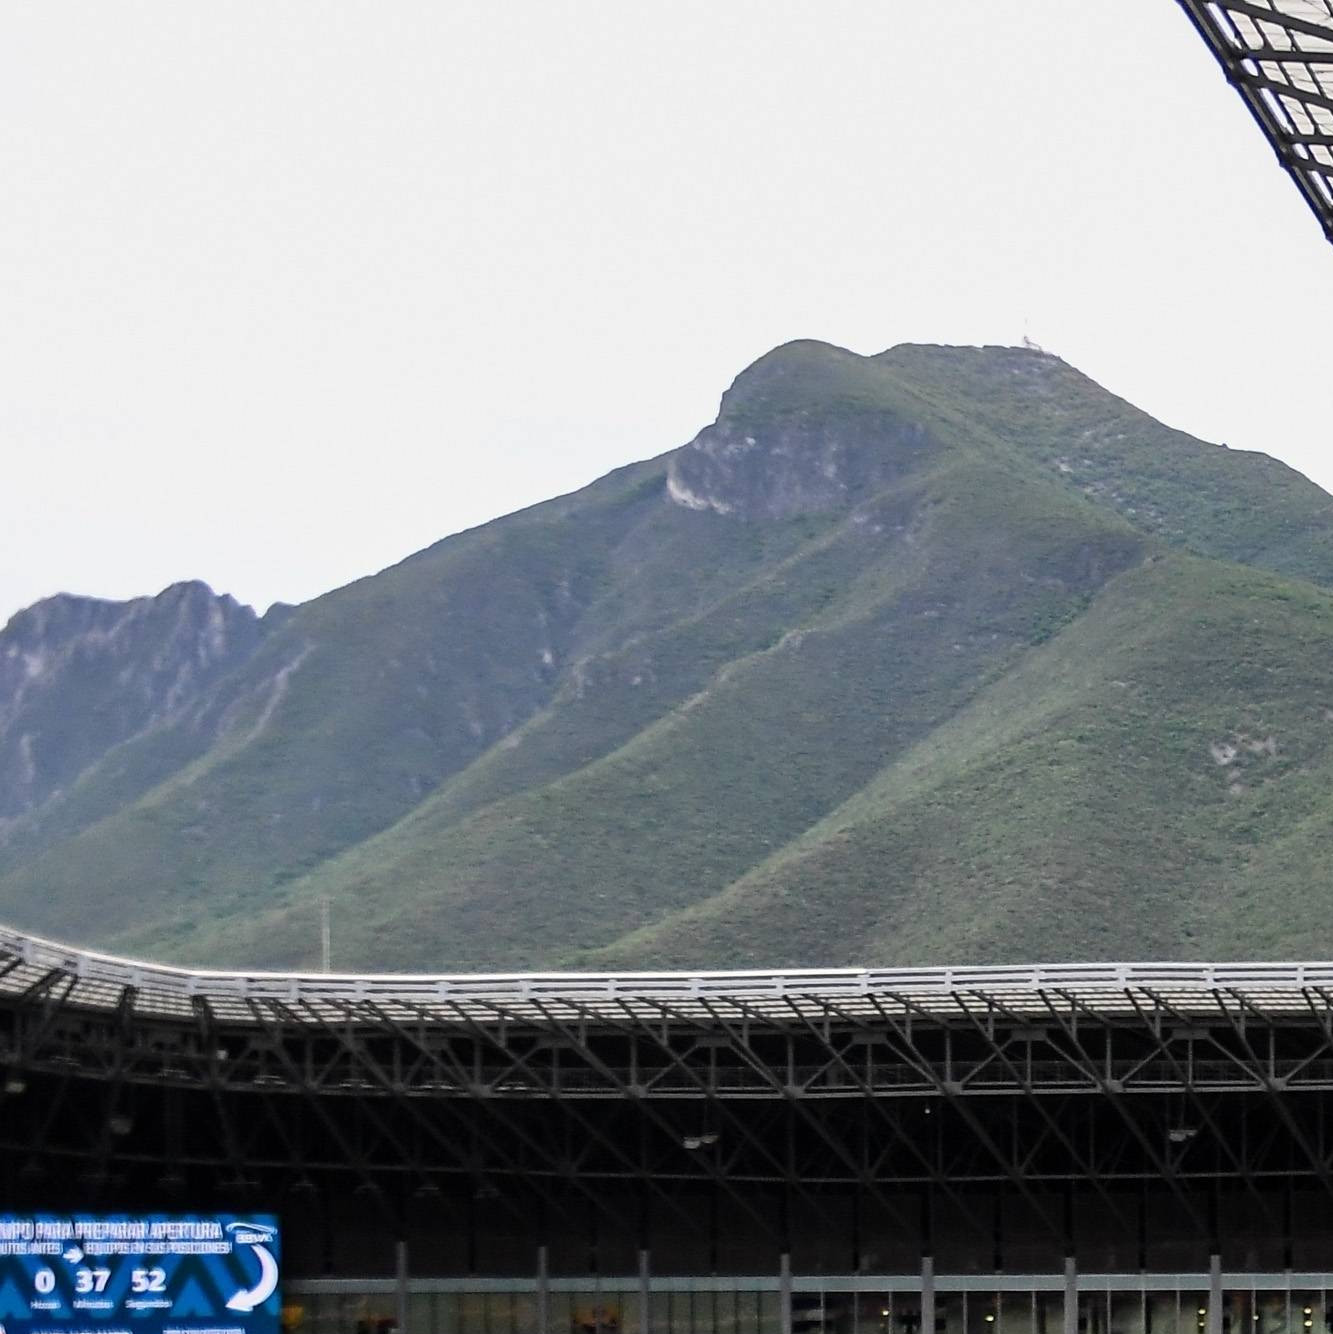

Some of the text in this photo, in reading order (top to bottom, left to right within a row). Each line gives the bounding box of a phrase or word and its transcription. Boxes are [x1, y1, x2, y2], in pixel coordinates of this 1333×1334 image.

[149, 1222, 223, 1239] APERTURA
[35, 1268, 166, 1293] 0 37 52
